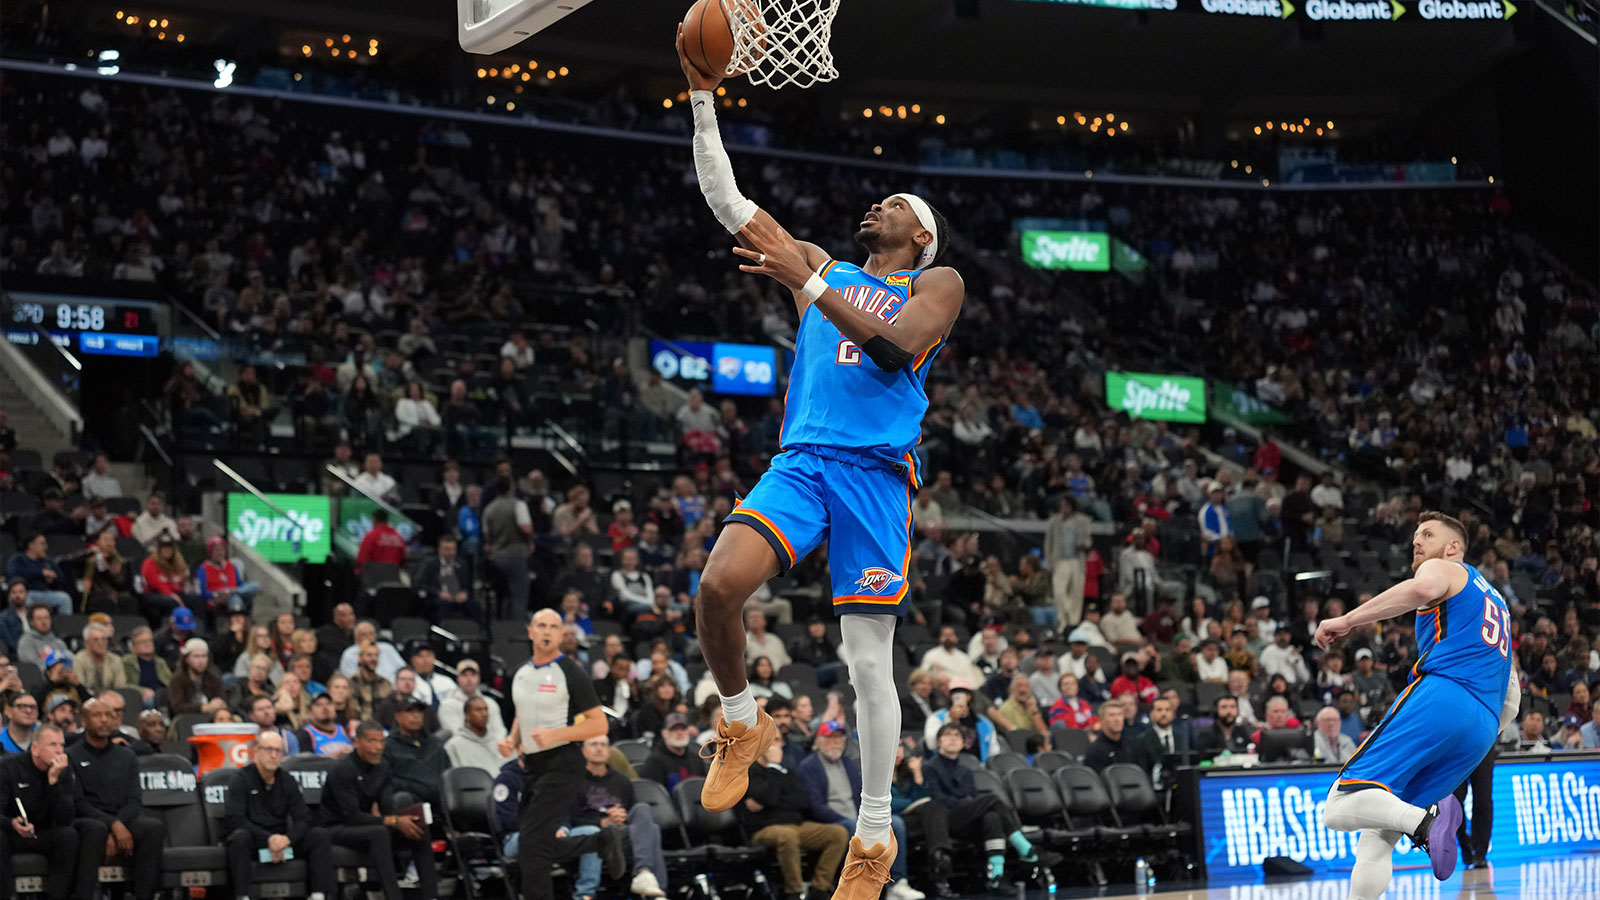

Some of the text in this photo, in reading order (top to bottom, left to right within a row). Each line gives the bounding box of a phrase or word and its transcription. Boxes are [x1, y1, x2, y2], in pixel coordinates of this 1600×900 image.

[1201, 0, 1282, 17] Globant
[1305, 0, 1392, 20] Globant
[1418, 0, 1503, 19] Globant
[1031, 235, 1099, 266] Sprite
[56, 304, 105, 330] 9:58
[1122, 379, 1191, 415] Sprite
[233, 508, 323, 547] Sprite
[1481, 593, 1510, 660] 55
[1512, 771, 1600, 846] NBASto
